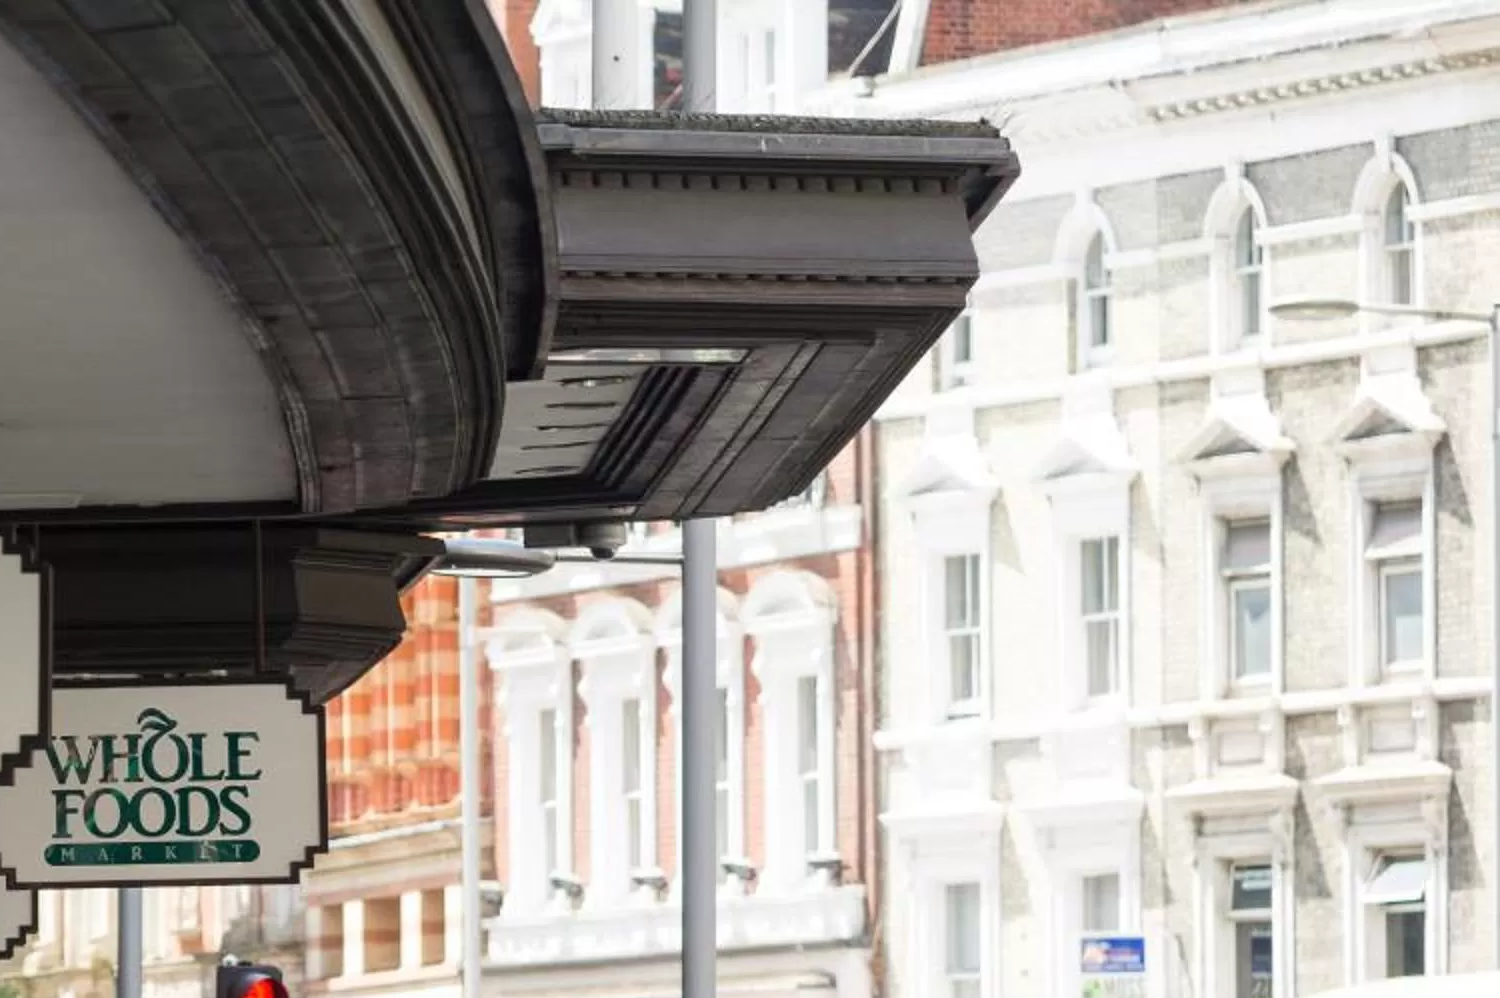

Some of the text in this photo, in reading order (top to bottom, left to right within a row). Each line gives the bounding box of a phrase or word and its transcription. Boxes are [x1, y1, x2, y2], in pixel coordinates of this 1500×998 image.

[46, 708, 262, 784] WHOLE
[52, 785, 251, 838] FOODS
[61, 843, 243, 862] MARKET
